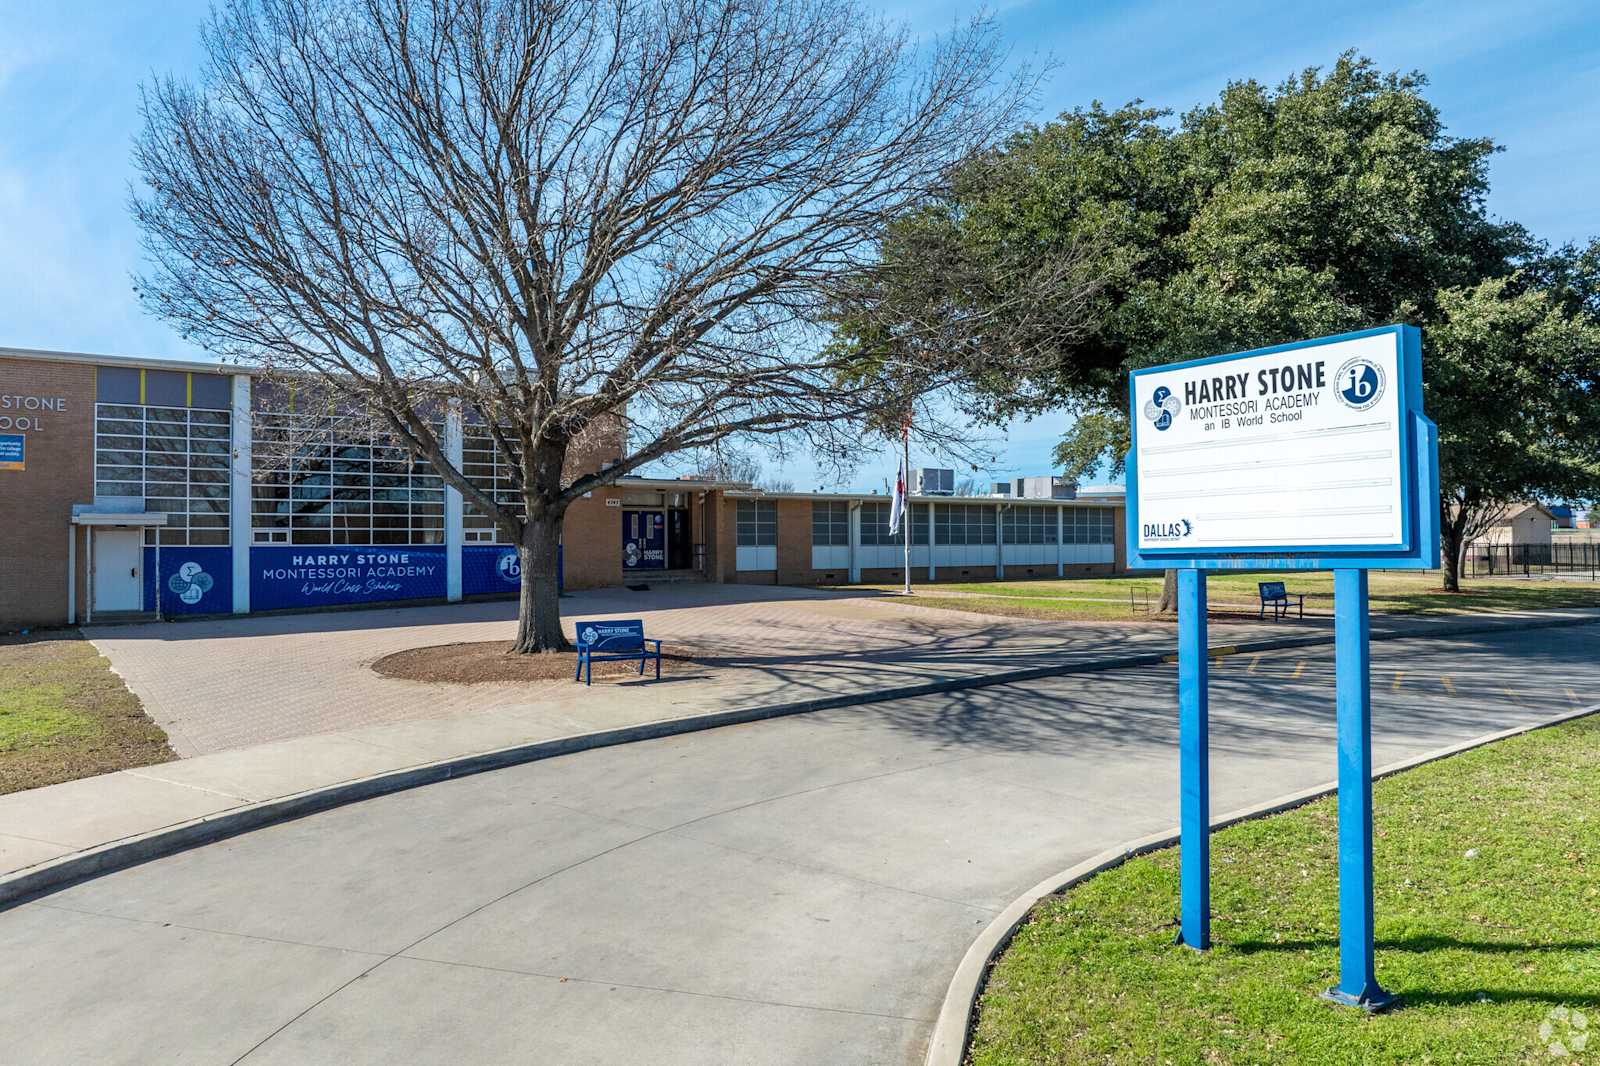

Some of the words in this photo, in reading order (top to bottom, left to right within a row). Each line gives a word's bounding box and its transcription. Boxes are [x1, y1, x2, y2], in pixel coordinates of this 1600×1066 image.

[1184, 372, 1249, 406] HARRY
[1257, 361, 1326, 396] STONE
[1, 394, 67, 412] STONE
[1190, 400, 1258, 421] MONTESSORI
[1265, 392, 1321, 411] ACADEMY
[0, 416, 44, 432] OOL
[1204, 422, 1215, 431] an
[1221, 418, 1231, 429] IB
[1236, 414, 1263, 427] World
[1270, 410, 1302, 424] School
[1144, 523, 1181, 537] DALLAS
[292, 555, 350, 566] HARRY
[356, 554, 409, 564] STONE
[263, 567, 361, 580] MONTESSORI
[366, 566, 436, 578] ACADEMY
[301, 580, 333, 596] World
[334, 579, 362, 594] Class
[363, 578, 402, 594] Scholars
